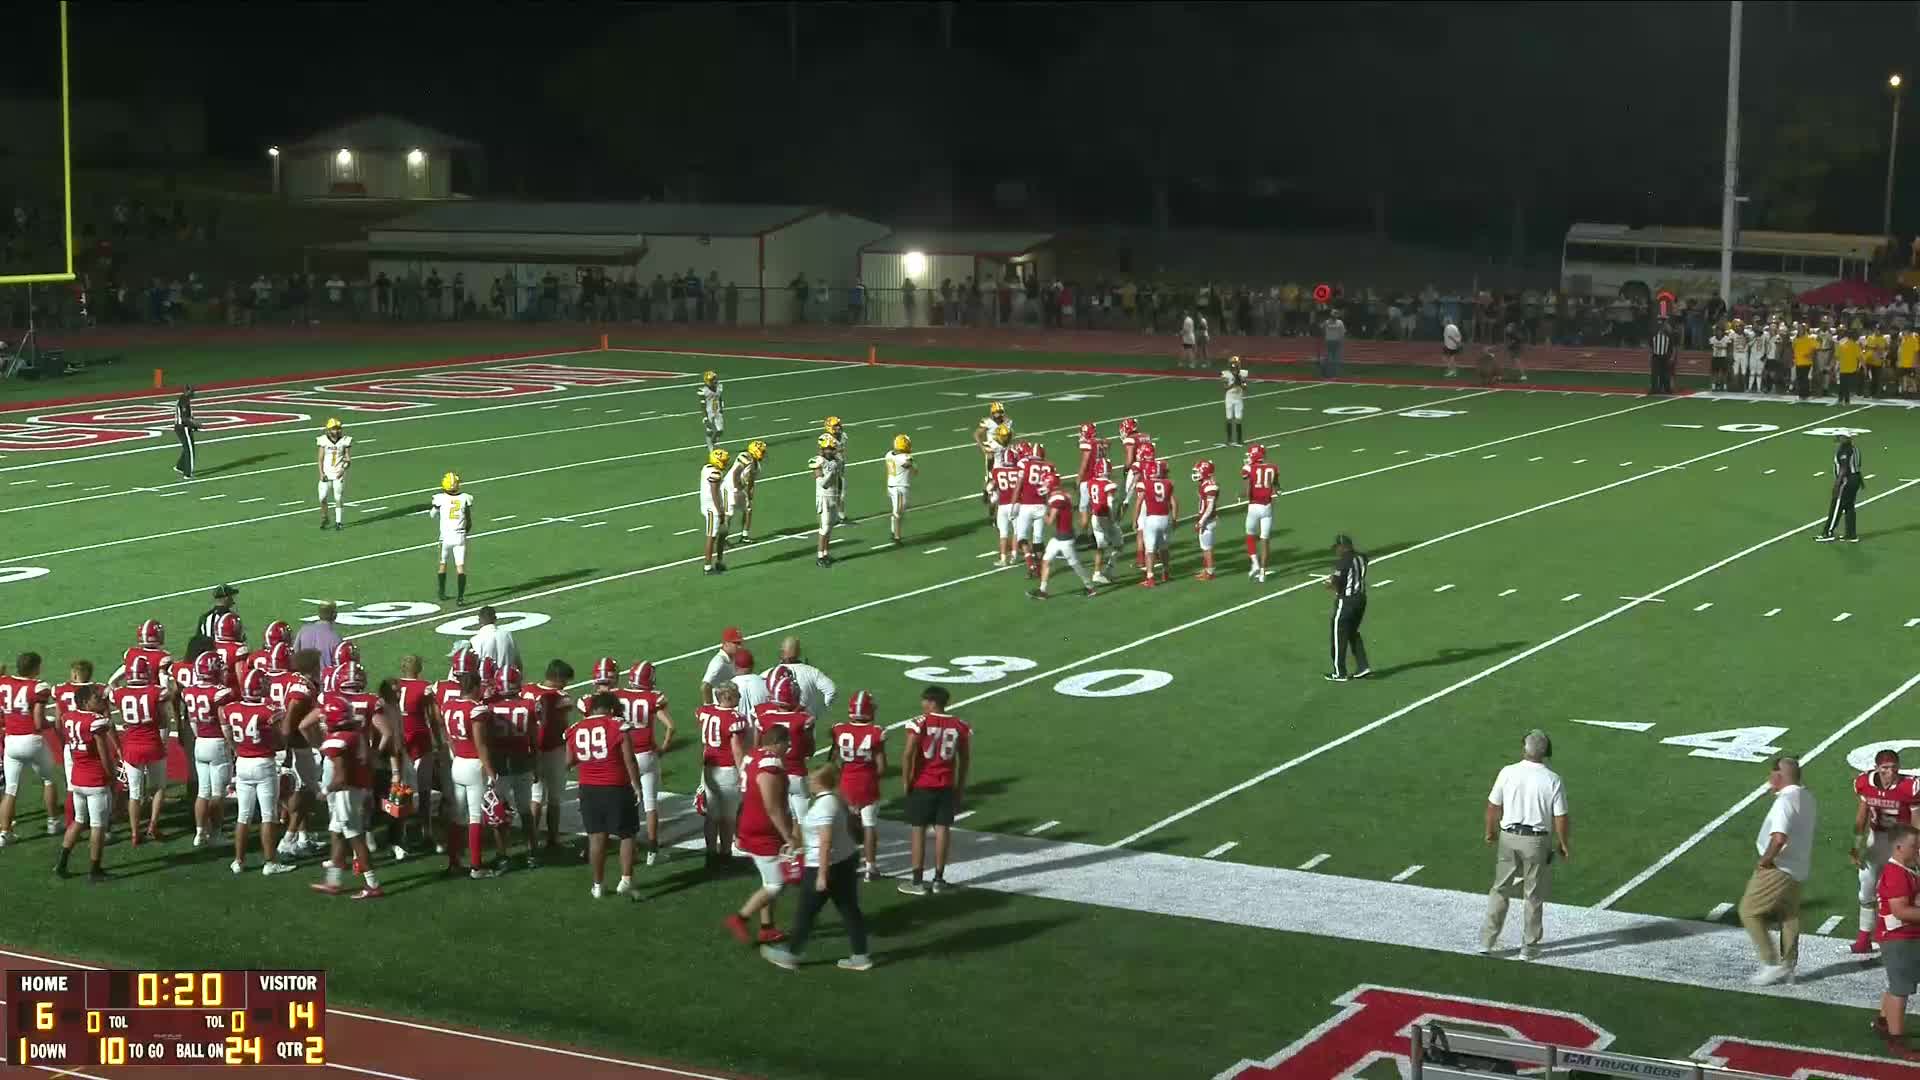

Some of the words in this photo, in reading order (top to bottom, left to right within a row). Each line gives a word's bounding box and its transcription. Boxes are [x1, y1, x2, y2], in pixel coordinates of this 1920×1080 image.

[997, 471, 1018, 491] 65
[1153, 482, 1165, 503] 9
[1255, 468, 1275, 489] 10
[449, 500, 461, 520] 2
[904, 655, 1163, 697] 30
[121, 694, 153, 724] 81
[229, 712, 262, 744] 64
[700, 712, 721, 748] 70
[575, 726, 608, 761] 99
[839, 733, 873, 763] 84
[922, 727, 959, 761] 78
[1595, 1058, 1641, 1073] TRUCK
[1643, 1065, 1681, 1079] BEDS
